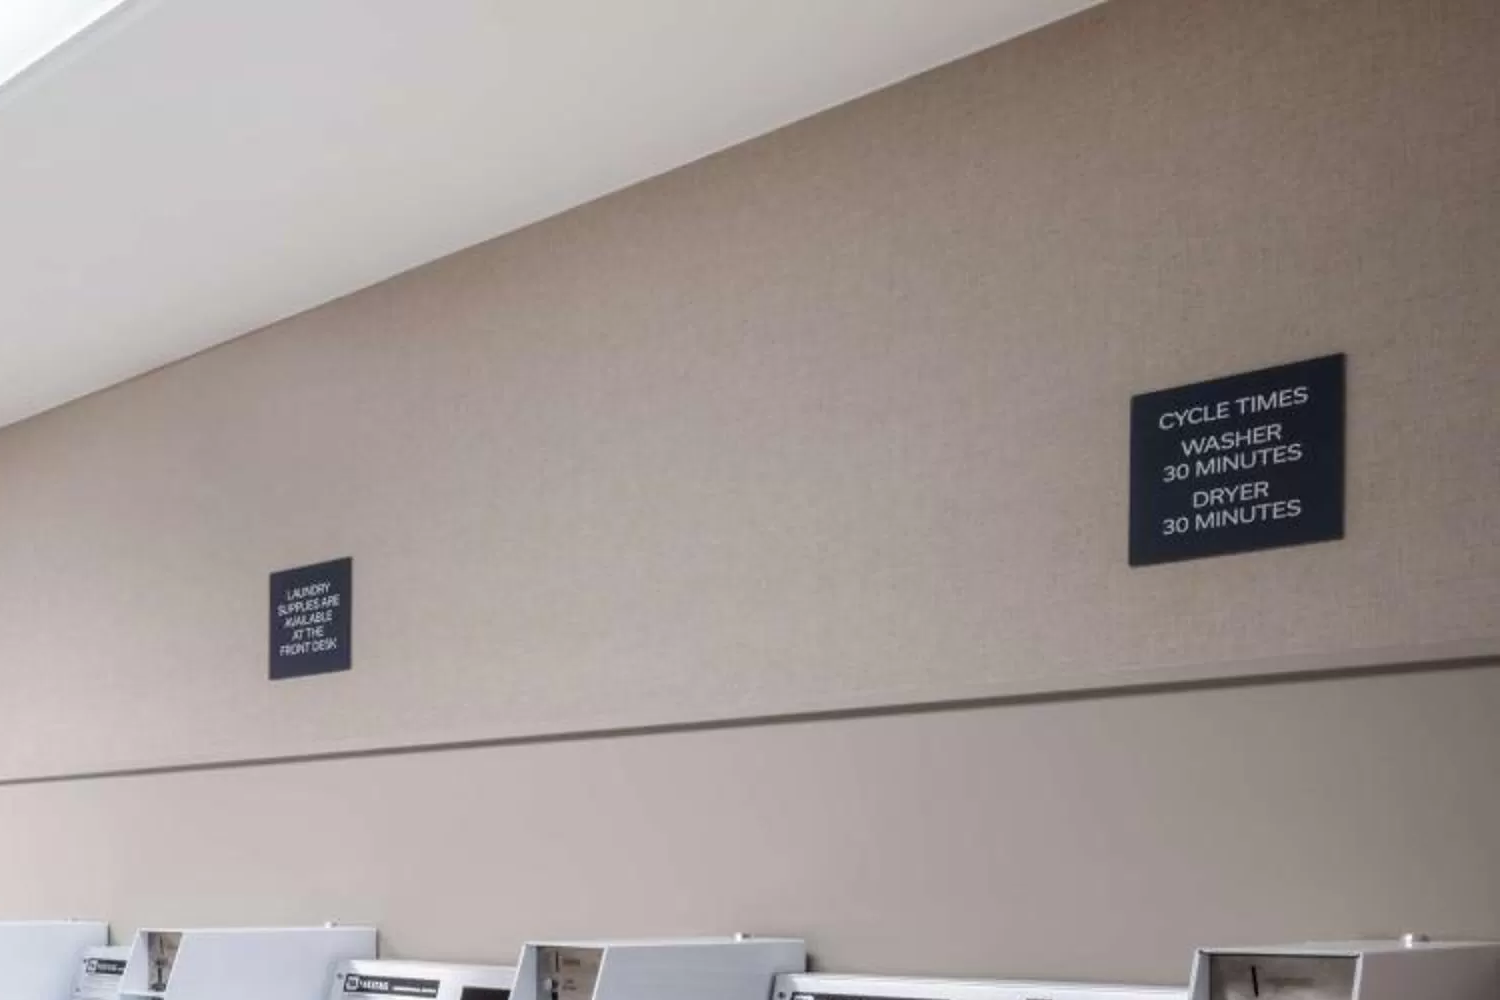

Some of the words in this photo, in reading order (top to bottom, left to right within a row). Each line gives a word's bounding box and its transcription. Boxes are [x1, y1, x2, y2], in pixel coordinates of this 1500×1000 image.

[1158, 401, 1231, 431] CYCLE
[1235, 385, 1309, 416] TIMES
[1180, 423, 1282, 457] WASHER
[1162, 463, 1190, 483] 30
[1195, 442, 1304, 478] MINUTES
[1193, 481, 1269, 509] DRYER
[1162, 517, 1189, 536] 30
[1195, 499, 1302, 532] MINUTES
[286, 582, 331, 601] LAUNDRY
[277, 598, 320, 617] SUPPLIES
[322, 593, 341, 608] ARE
[284, 609, 333, 629] AVAILABLE
[292, 629, 304, 641] AT
[306, 625, 325, 639] THE
[279, 641, 311, 657] FRONT
[311, 636, 338, 653] DESK
